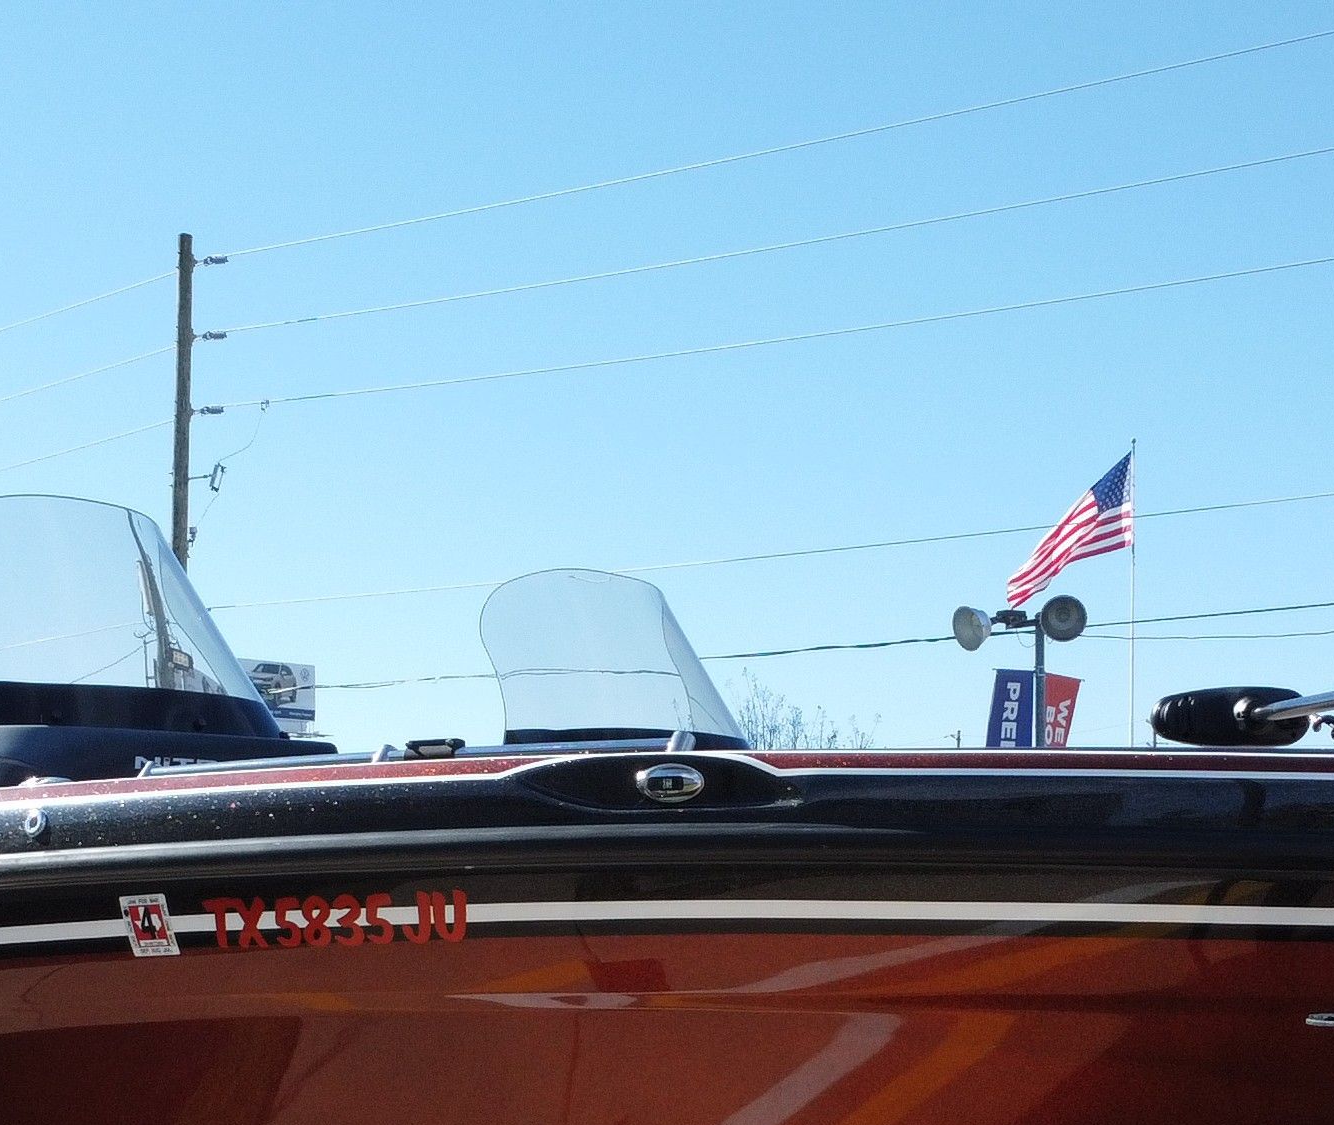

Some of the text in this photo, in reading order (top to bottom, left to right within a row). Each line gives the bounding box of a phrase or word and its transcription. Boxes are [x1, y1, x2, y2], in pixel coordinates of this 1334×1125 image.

[1054, 699, 1071, 744] WE
[141, 905, 157, 940] 4
[202, 886, 467, 949] TX 5835 JU
